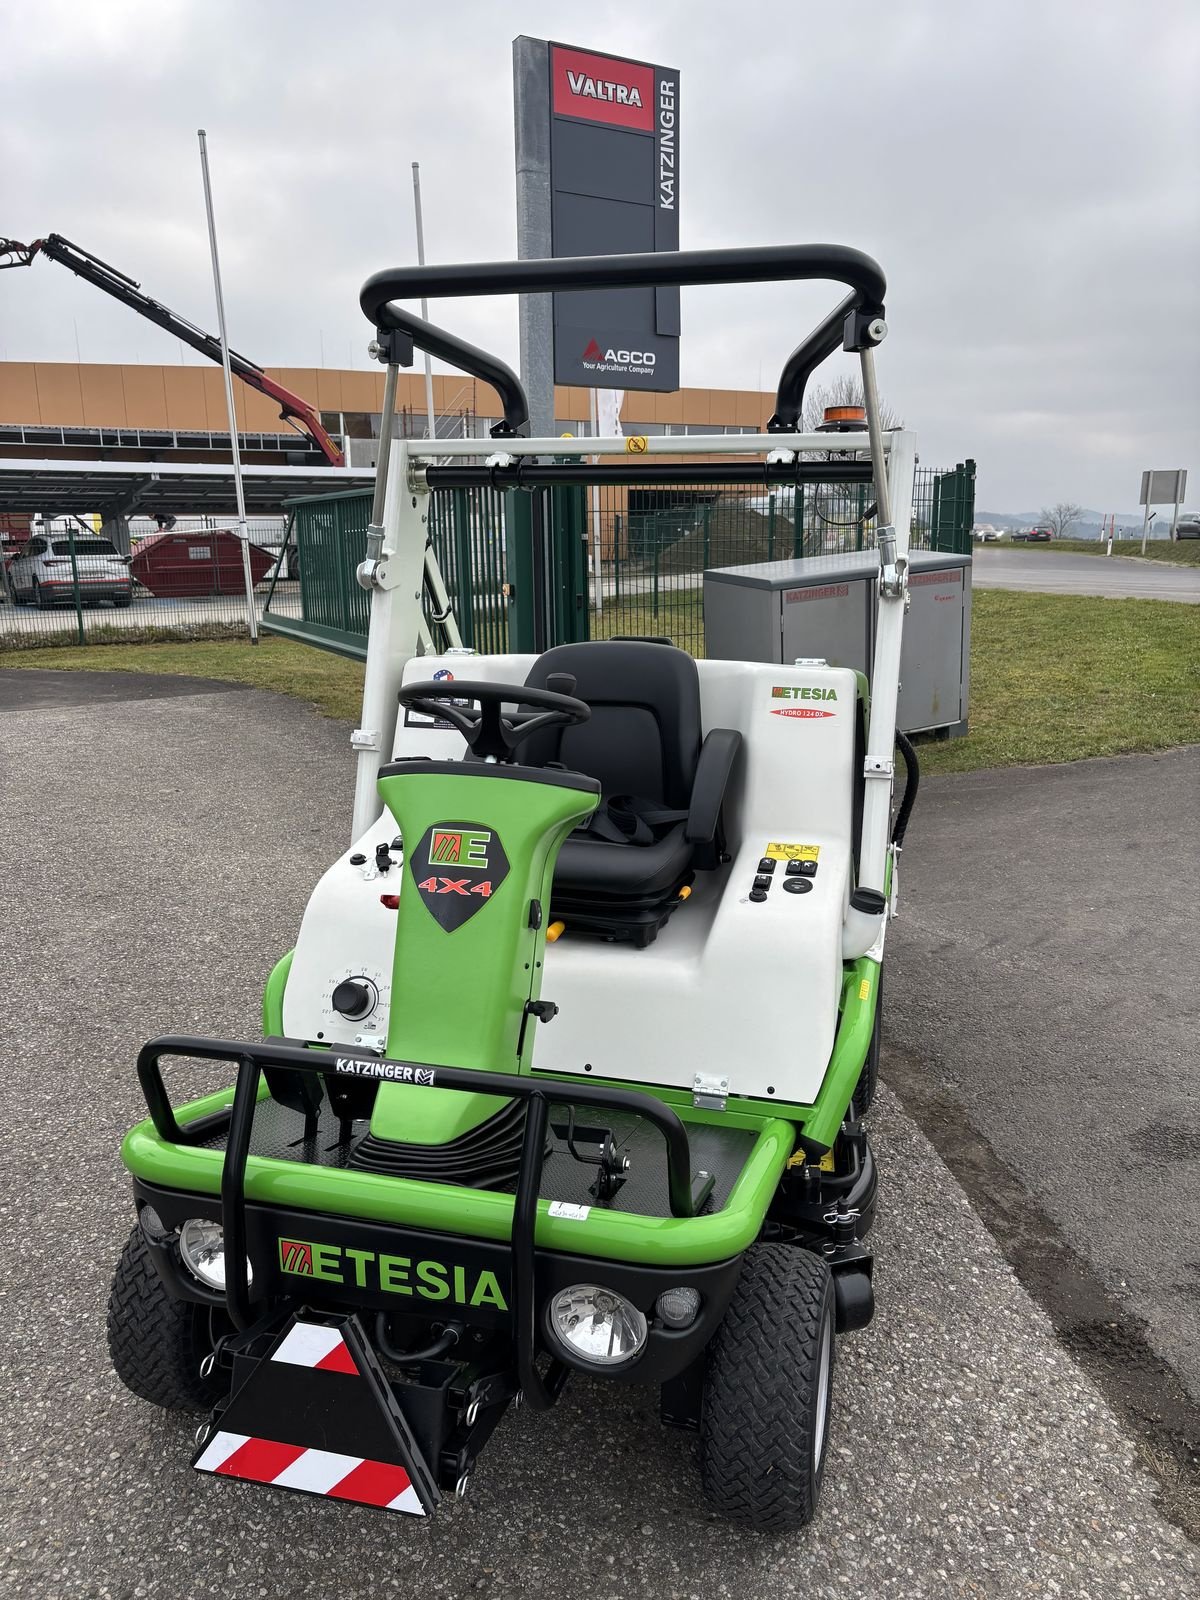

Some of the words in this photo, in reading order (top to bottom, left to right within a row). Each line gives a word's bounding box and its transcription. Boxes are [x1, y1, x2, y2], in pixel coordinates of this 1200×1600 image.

[566, 69, 643, 108] VALTRA
[660, 80, 674, 209] KATZINGER
[604, 349, 656, 365] AGCO
[582, 361, 596, 369] Your
[596, 362, 627, 372] Agriculture
[629, 365, 655, 376] Company
[786, 586, 836, 602] KATZINGER
[772, 686, 837, 701] ETESIA
[336, 1058, 413, 1081] KATZINGER
[278, 1237, 509, 1311] ETESIA
